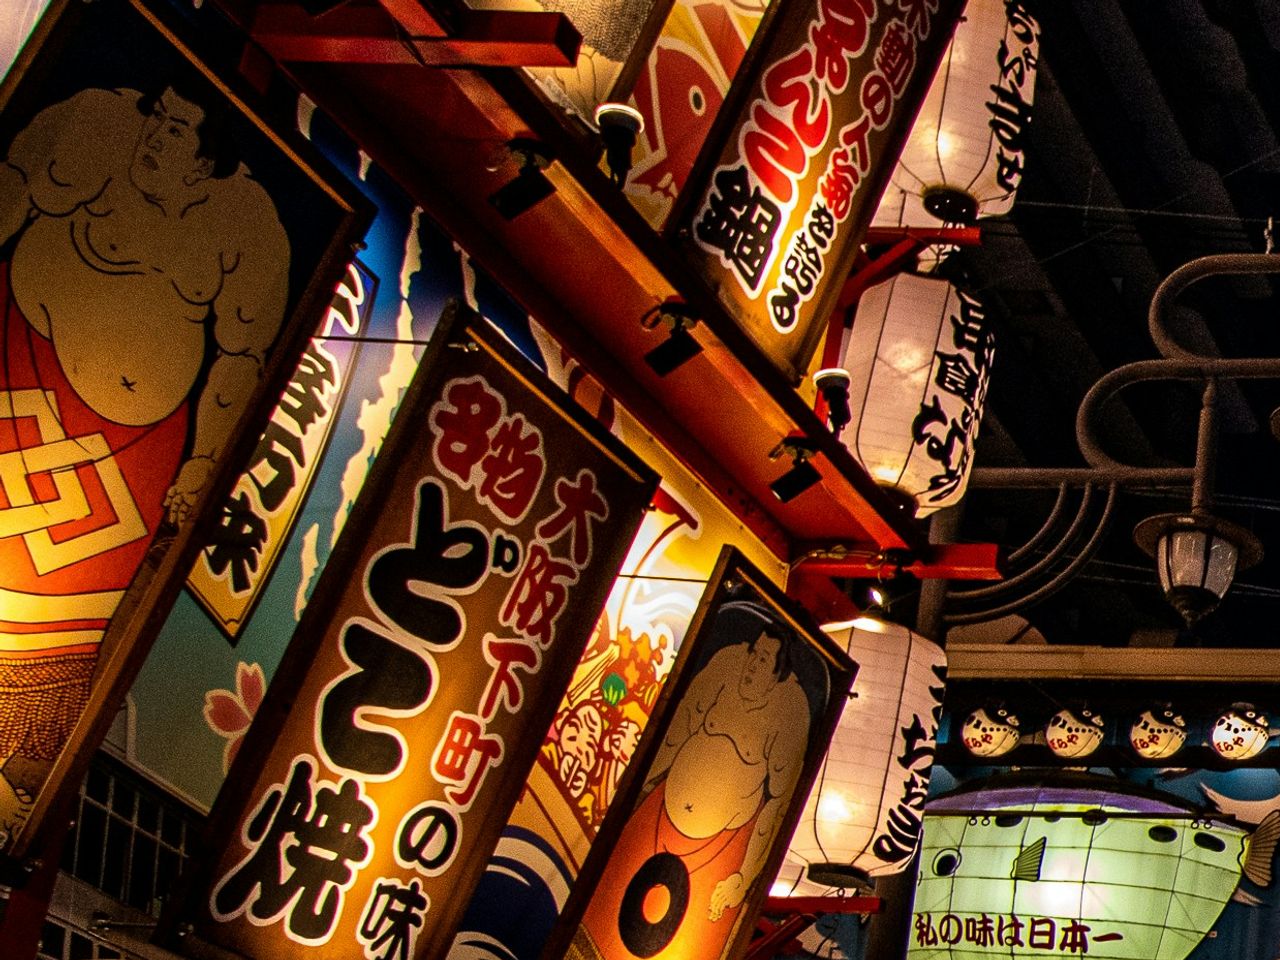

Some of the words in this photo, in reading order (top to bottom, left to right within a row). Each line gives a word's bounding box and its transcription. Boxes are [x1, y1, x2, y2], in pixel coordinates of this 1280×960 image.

[915, 913, 1124, 954] 私の味は日本一
